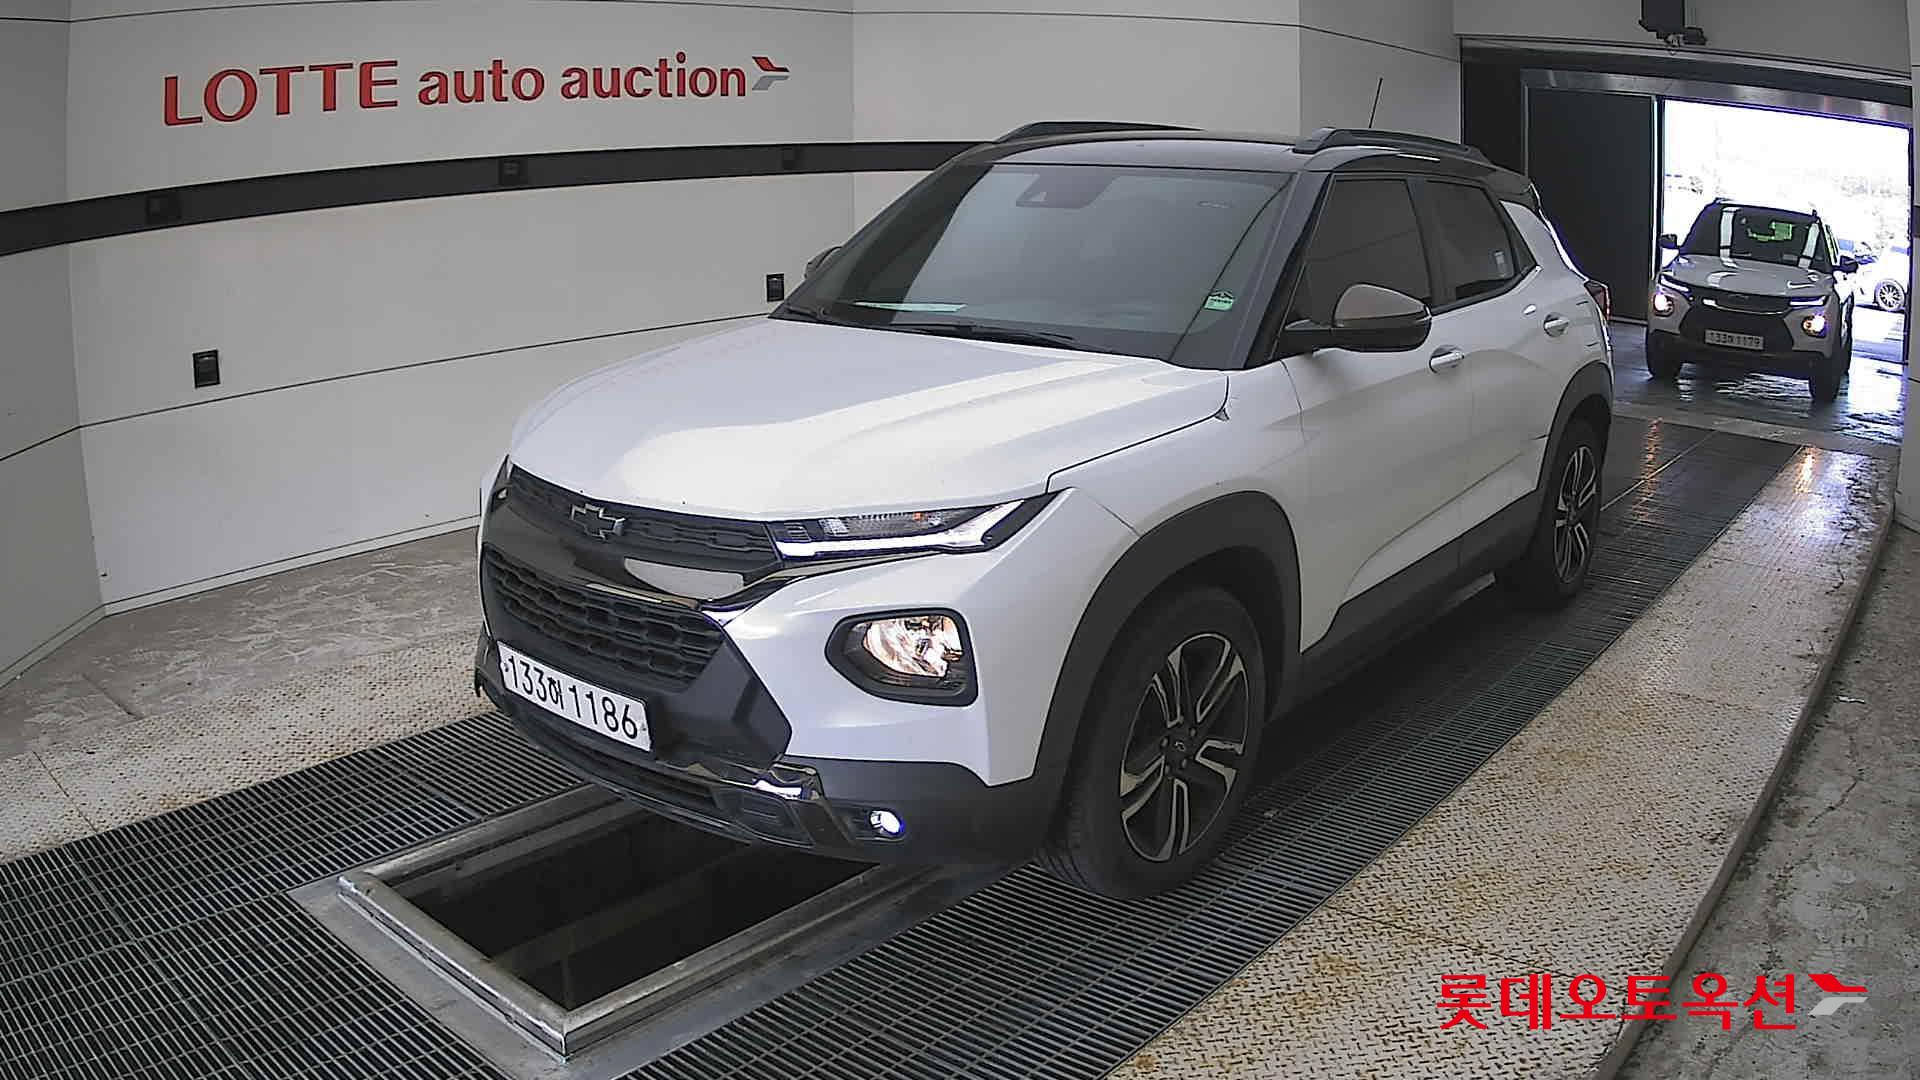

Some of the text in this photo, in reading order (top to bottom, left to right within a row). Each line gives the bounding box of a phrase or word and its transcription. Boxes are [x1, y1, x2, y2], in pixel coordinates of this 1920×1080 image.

[164, 52, 747, 126] LOTTE auto auction
